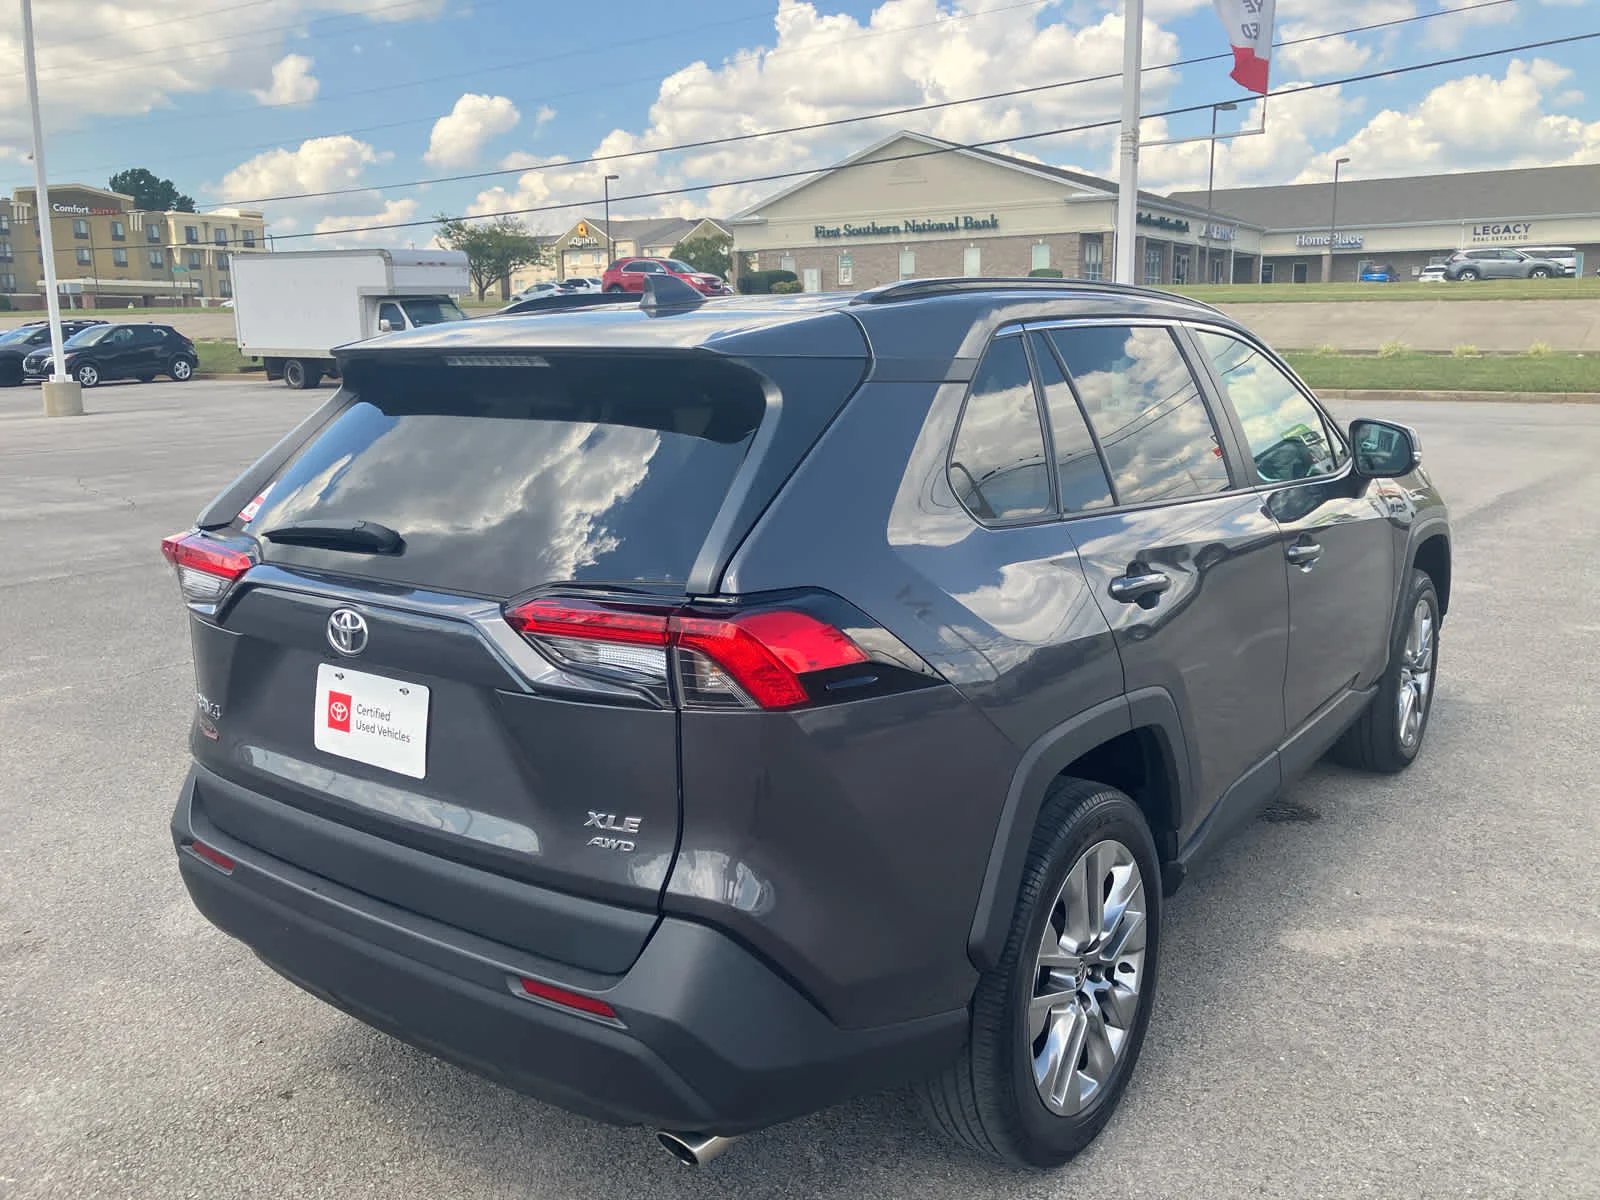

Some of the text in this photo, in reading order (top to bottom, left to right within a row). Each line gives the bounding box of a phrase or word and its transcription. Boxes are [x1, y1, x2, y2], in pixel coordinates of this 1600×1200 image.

[53, 203, 89, 214] Comfort
[815, 213, 999, 238] First Southern National Bank
[1473, 224, 1532, 236] LEGACY
[356, 704, 391, 722] Certified
[355, 720, 411, 743] Used Vehicles
[584, 811, 642, 833] XLE
[586, 837, 635, 851] AWD
